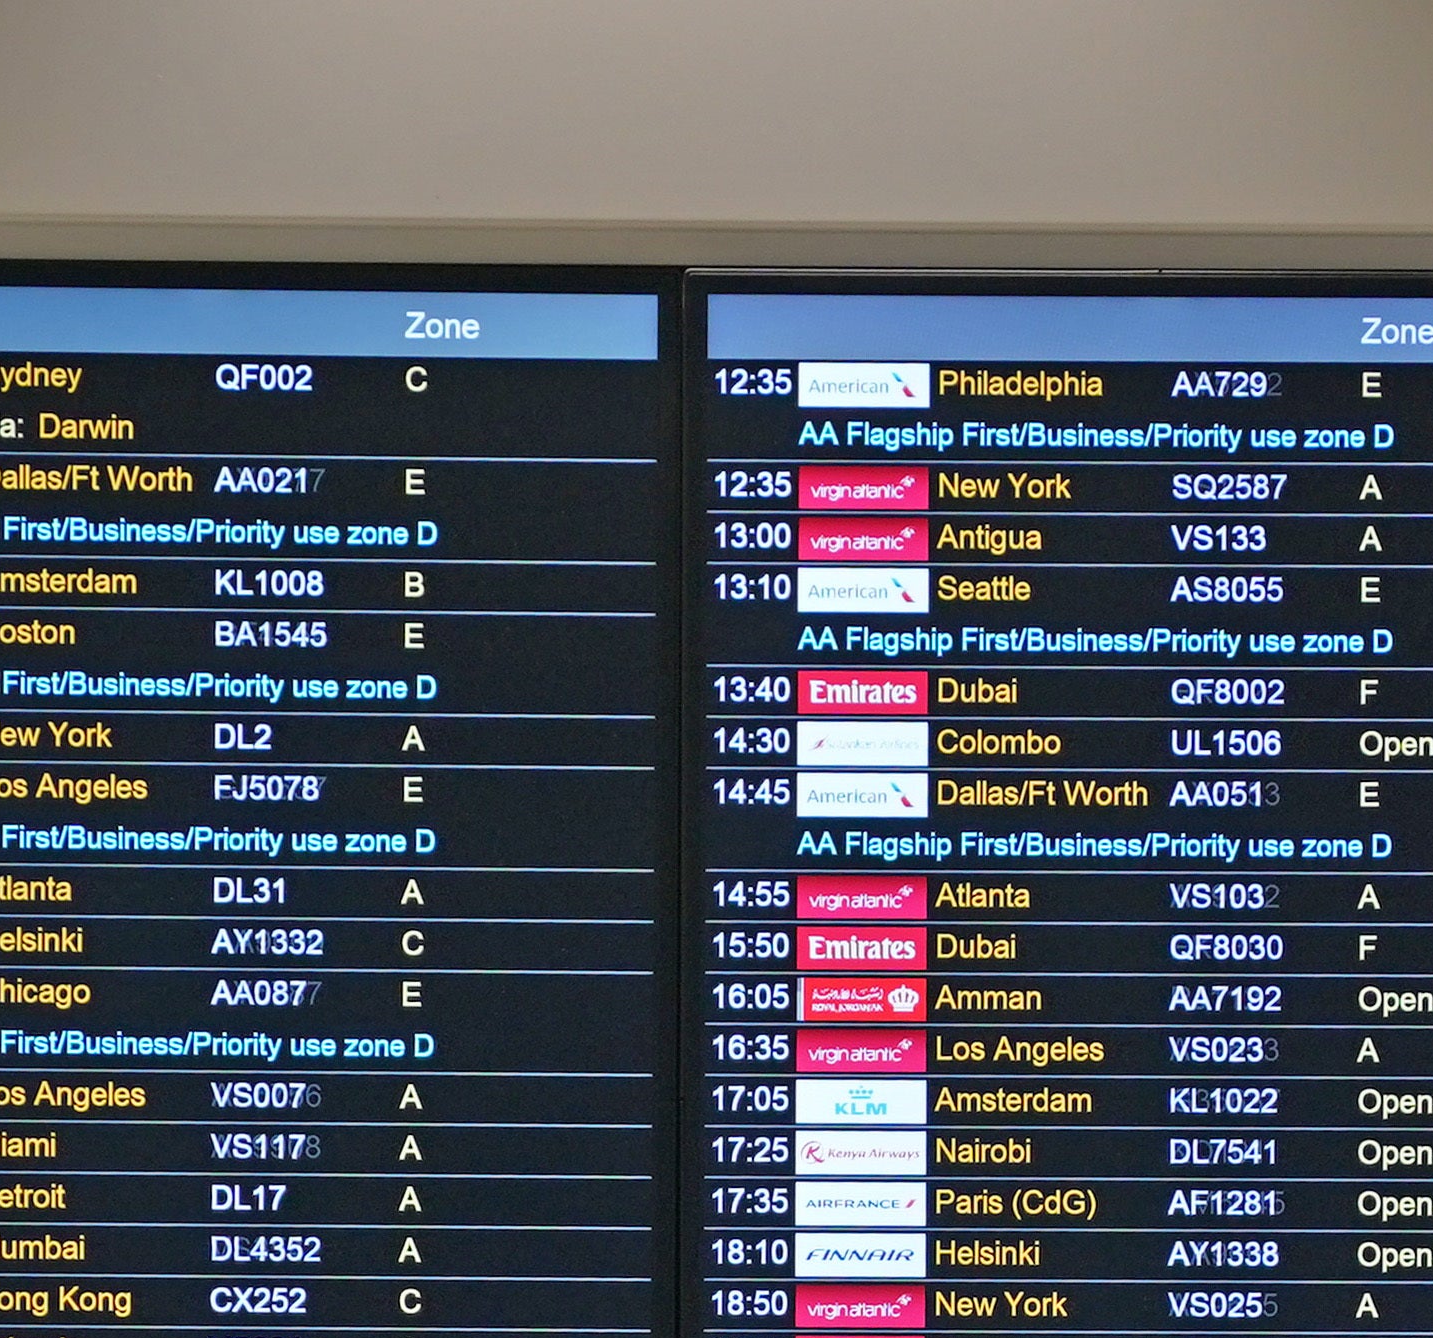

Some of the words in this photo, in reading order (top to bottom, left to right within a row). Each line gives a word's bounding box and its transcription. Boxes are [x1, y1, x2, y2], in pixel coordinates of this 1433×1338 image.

[405, 312, 480, 339] Zone
[216, 364, 312, 391] QF002
[406, 366, 427, 392] C
[40, 413, 133, 439] Darwin
[107, 465, 192, 491] Worth
[4, 516, 285, 549] First/Business/Priority
[294, 526, 340, 545] use
[347, 526, 409, 546] zone
[418, 521, 438, 547] D
[715, 522, 791, 549] 13:00
[937, 524, 1041, 555] Antigua
[1171, 525, 1266, 552] VS133
[1360, 526, 1382, 551] A
[714, 574, 791, 600] 13:10
[938, 575, 1031, 600] Seattle
[1170, 576, 1283, 603] AS8055
[1361, 577, 1380, 602] E
[48, 722, 112, 747] York
[215, 723, 272, 750] DL2
[402, 726, 425, 751] A
[714, 727, 790, 753] 14:30
[938, 729, 1061, 754] Colombo
[1172, 730, 1281, 756] UL1506
[806, 1247, 915, 1263] FINNAIR
[60, 1286, 131, 1317] Kong
[210, 1287, 306, 1313] CX252
[400, 1289, 421, 1313] C
